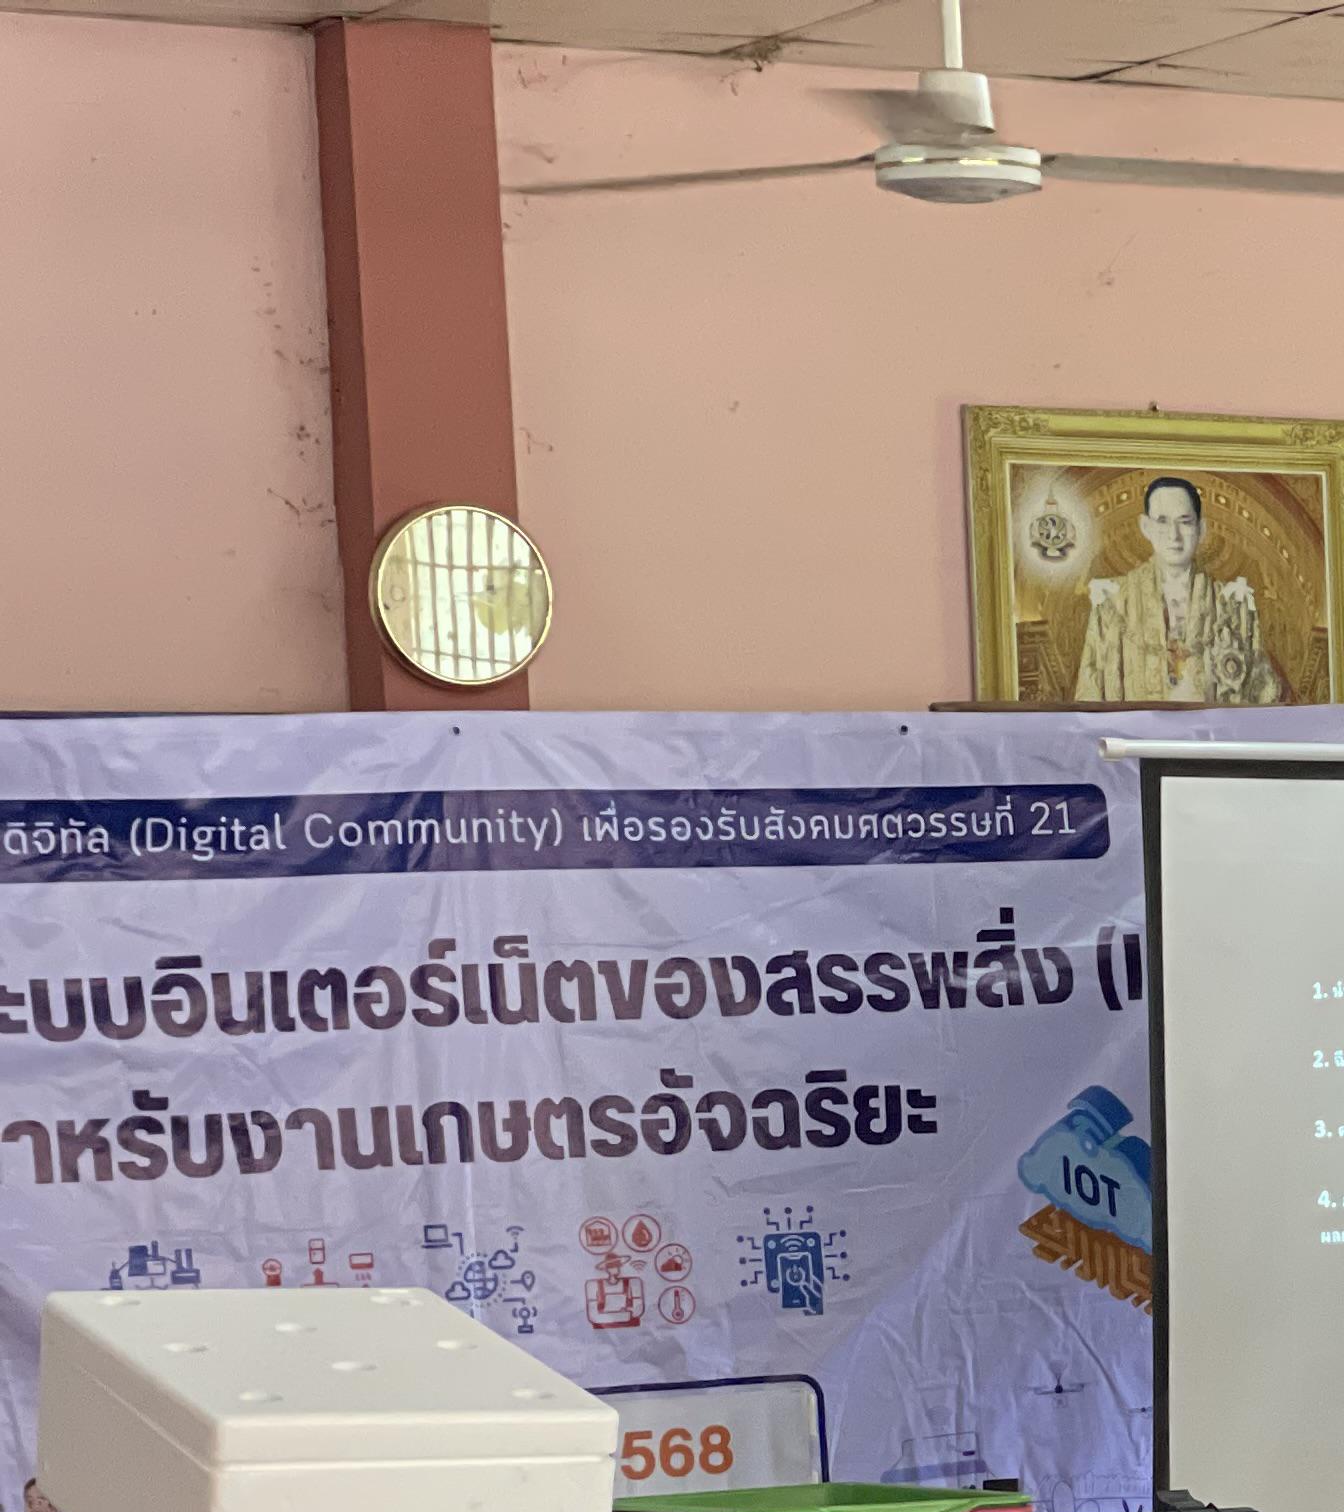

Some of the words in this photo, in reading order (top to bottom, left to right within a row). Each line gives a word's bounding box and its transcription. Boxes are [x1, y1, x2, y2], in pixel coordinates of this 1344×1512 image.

[129, 812, 288, 862] (Digital
[303, 807, 563, 851] Community)
[582, 794, 1016, 844] เพื่อรองรับสังคมศตวรรษที่
[1029, 801, 1077, 836] 21
[1312, 981, 1329, 1001] 1.
[1312, 1049, 1330, 1069] 2.
[1314, 1119, 1333, 1139] 3.
[1317, 1189, 1337, 1208] 4.
[620, 1424, 734, 1481] 568
